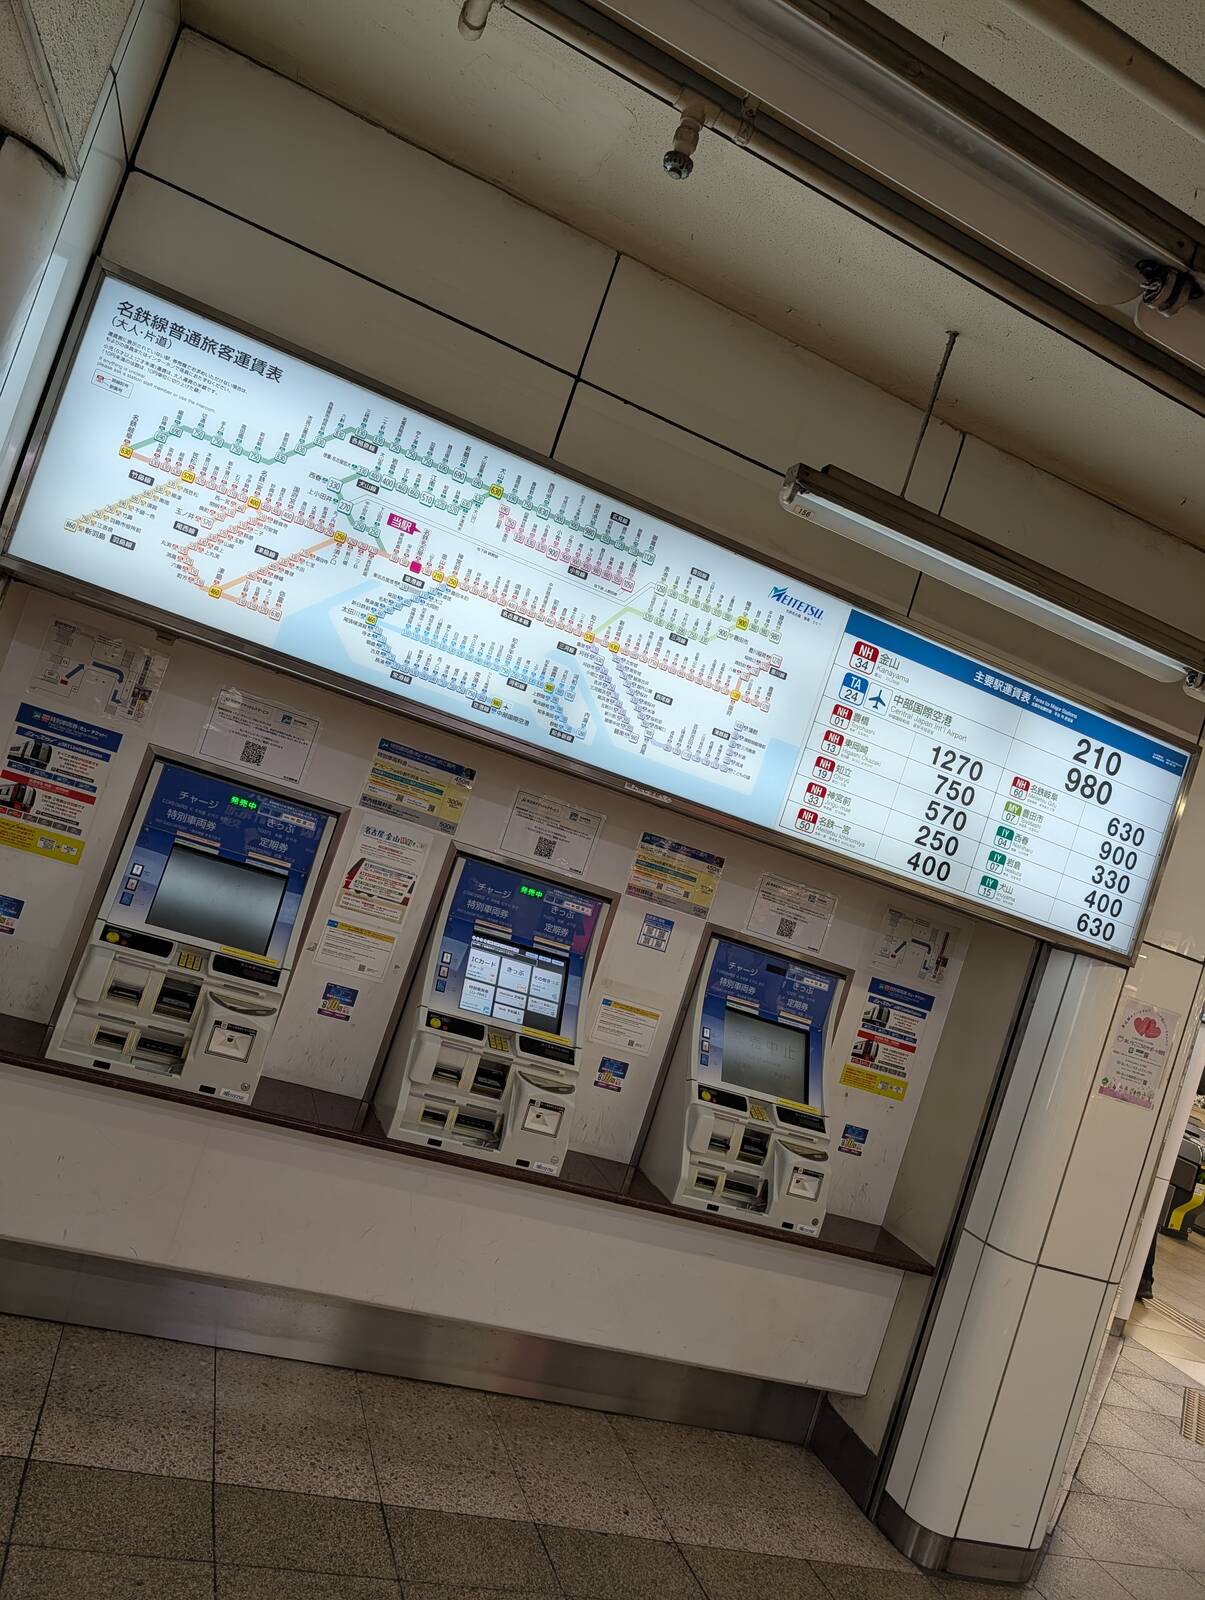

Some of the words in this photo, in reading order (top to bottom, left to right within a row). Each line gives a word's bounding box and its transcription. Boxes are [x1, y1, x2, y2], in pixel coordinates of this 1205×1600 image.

[117, 301, 284, 384] 名鉄線普通旅客運賃表
[182, 471, 194, 481] 570
[455, 471, 465, 480] 690
[329, 480, 340, 490] 330
[383, 478, 394, 488] 400
[491, 487, 500, 496] 630
[422, 494, 433, 504] 510
[340, 503, 351, 512] 270
[799, 508, 811, 517] 156
[391, 515, 412, 532] 当駅
[768, 586, 823, 619] MEITETSU
[858, 644, 873, 658] NH
[854, 658, 868, 670] 34
[878, 653, 900, 670] 金山
[877, 665, 909, 684] Kanayama
[850, 676, 861, 690] TA
[974, 671, 1032, 704] 主要駅運賃表
[845, 690, 858, 702] 24
[837, 706, 849, 718] NH
[893, 694, 953, 726] 中部国際空港
[834, 715, 845, 726] 01
[890, 705, 913, 721] Central
[913, 713, 933, 728] Japan
[946, 725, 967, 743] Airport
[828, 733, 840, 744] NH
[826, 742, 836, 753] 13
[820, 759, 832, 769] NH
[932, 746, 983, 781] 1270
[1073, 739, 1121, 776] 210
[817, 768, 828, 779] 19
[835, 765, 852, 777] 知立
[811, 784, 823, 795] NH
[935, 774, 975, 806] 750
[1016, 780, 1027, 789] NH
[1064, 768, 1112, 805] 980
[808, 794, 819, 804] 33
[827, 790, 851, 807] 神宮前
[1013, 788, 1024, 798] 60
[1030, 784, 1058, 801] 名鉄岐阜
[179, 791, 218, 809] チャージ
[230, 795, 257, 809] 発売中
[1007, 803, 1019, 813] MY
[167, 808, 217, 832] 特別車両券
[801, 811, 814, 822] NH
[925, 800, 967, 831] 570
[1005, 813, 1016, 823] 07
[266, 818, 296, 833] きっぷ
[799, 821, 811, 831] 50
[816, 825, 838, 837] Meitetsu
[819, 816, 851, 835] 名鉄一宮
[1107, 818, 1145, 846] 630
[1001, 828, 1010, 838] IY
[258, 837, 289, 853] 定期券
[915, 825, 959, 856] 250
[997, 837, 1008, 847] 04
[993, 853, 1002, 863] IY
[1099, 841, 1137, 870] 900
[907, 852, 950, 881] 400
[989, 862, 1000, 872] 07
[985, 878, 994, 888] IY
[1091, 865, 1130, 894] 330
[477, 883, 512, 899] チャージ
[520, 885, 544, 898] 発売中
[981, 887, 991, 897] 15
[998, 883, 1014, 895] 犬山
[466, 899, 509, 919] 特別車両券
[1084, 891, 1122, 917] 400
[551, 906, 576, 919] きっぷ
[544, 923, 569, 937] 定期券
[1077, 913, 1115, 941] 630
[728, 961, 759, 976] チャージ
[719, 977, 757, 995] 特別車両券
[792, 982, 814, 995] きっぷ
[787, 999, 808, 1012] 定期券
